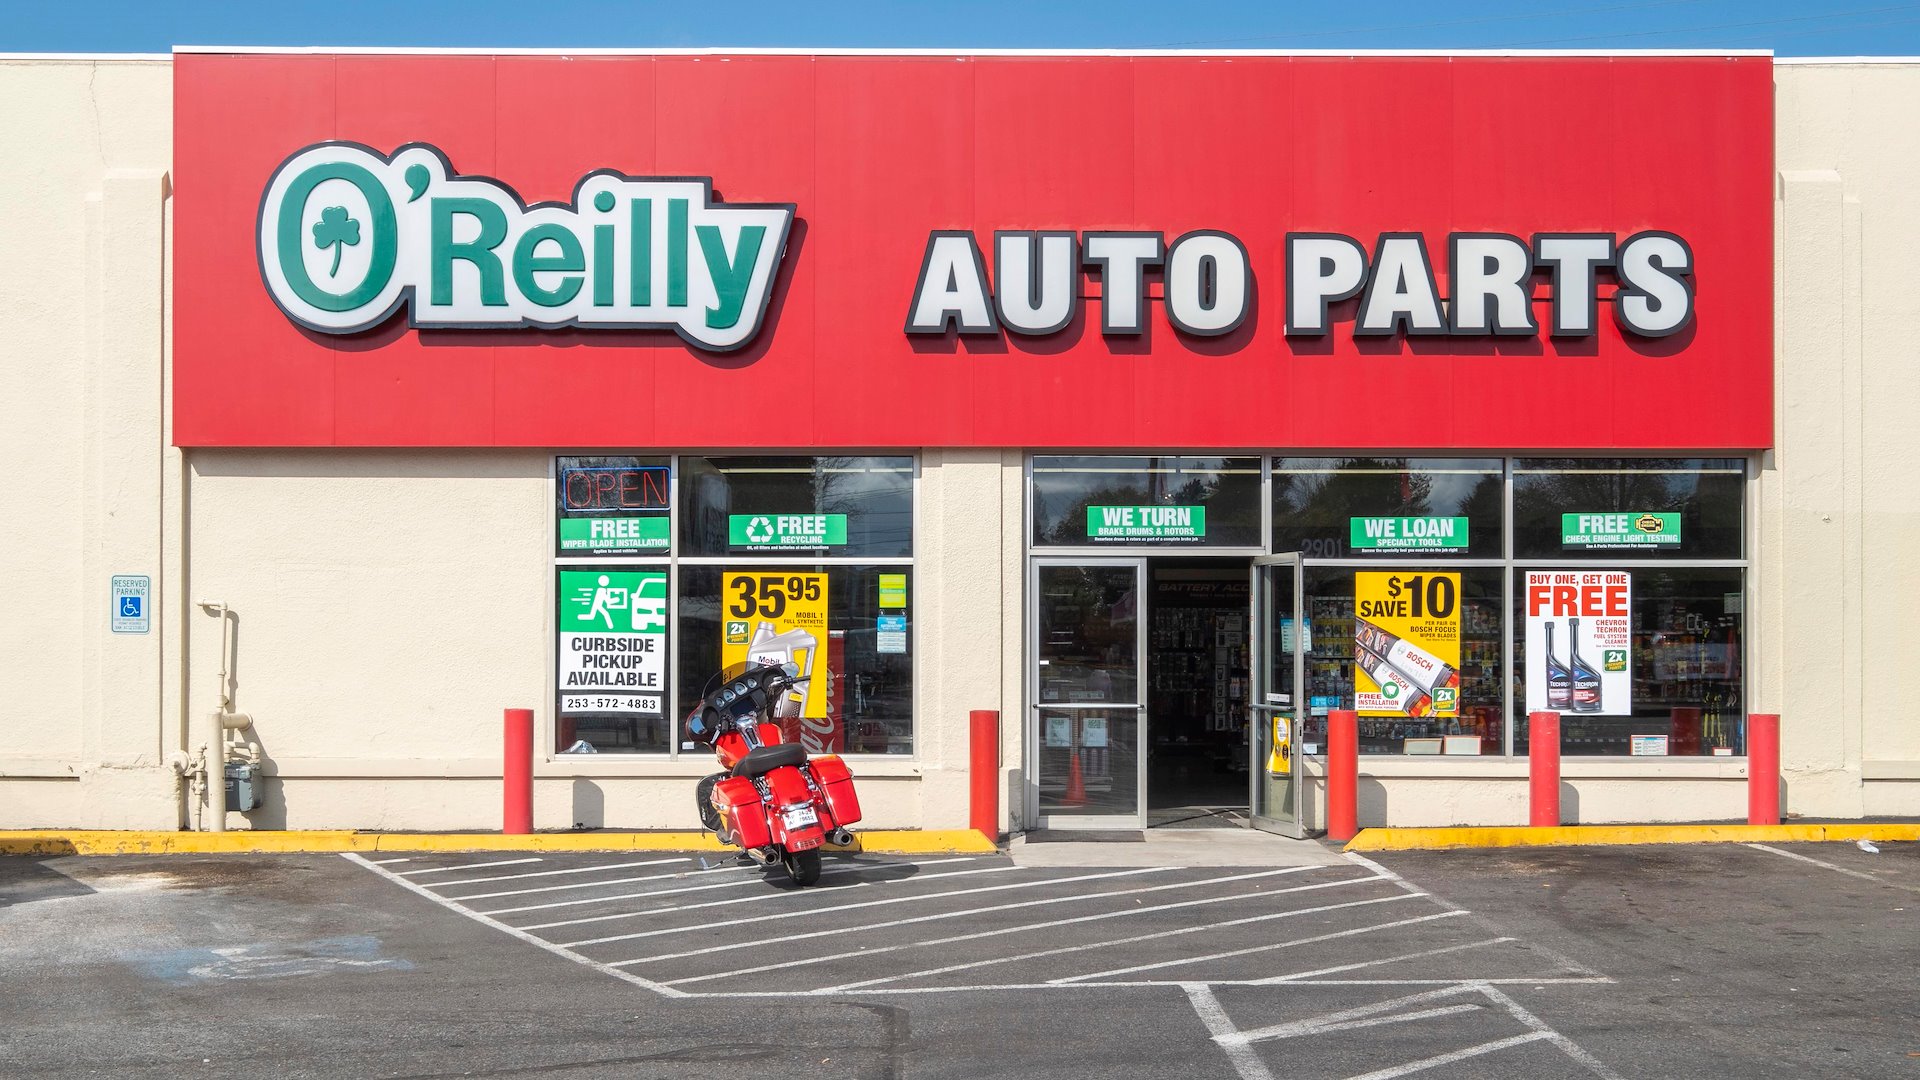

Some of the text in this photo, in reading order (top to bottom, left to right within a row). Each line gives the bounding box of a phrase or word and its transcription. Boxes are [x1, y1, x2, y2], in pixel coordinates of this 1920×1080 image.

[277, 161, 767, 330] O'Reilly
[905, 229, 1694, 336] AUTO PARTS
[567, 470, 667, 507] OPEN
[777, 516, 826, 534] FREE
[1102, 508, 1190, 526] WE TURN
[1579, 515, 1628, 534] FREE
[590, 520, 640, 538] FREE
[1364, 518, 1454, 538] WE LOAN
[563, 540, 587, 548] WIPER
[616, 539, 668, 547] INSTALLATION
[1376, 538, 1442, 547] SPECIALTY TOOLS
[1566, 534, 1678, 543] CHECK ENGINE LIGHT TESTING
[1301, 538, 1343, 558] 2901
[1158, 584, 1218, 592] BATTERY
[1530, 574, 1626, 586] BUY ONE, GET ONE
[730, 576, 820, 618] 35 95
[1388, 576, 1454, 618] $10
[1530, 586, 1627, 616] FREE
[1360, 600, 1407, 617] SAVE
[730, 623, 745, 634] 2x
[572, 637, 654, 652] CURBSIDE
[582, 654, 643, 669] PICKUP
[758, 656, 780, 664] Mobil
[1406, 651, 1433, 671] BOSCH
[1608, 652, 1622, 662] 2x
[567, 672, 656, 686] AVAILABLE
[1388, 672, 1409, 690] BOSCH
[568, 698, 656, 709] 253-572-4883
[1437, 690, 1452, 701] 2x
